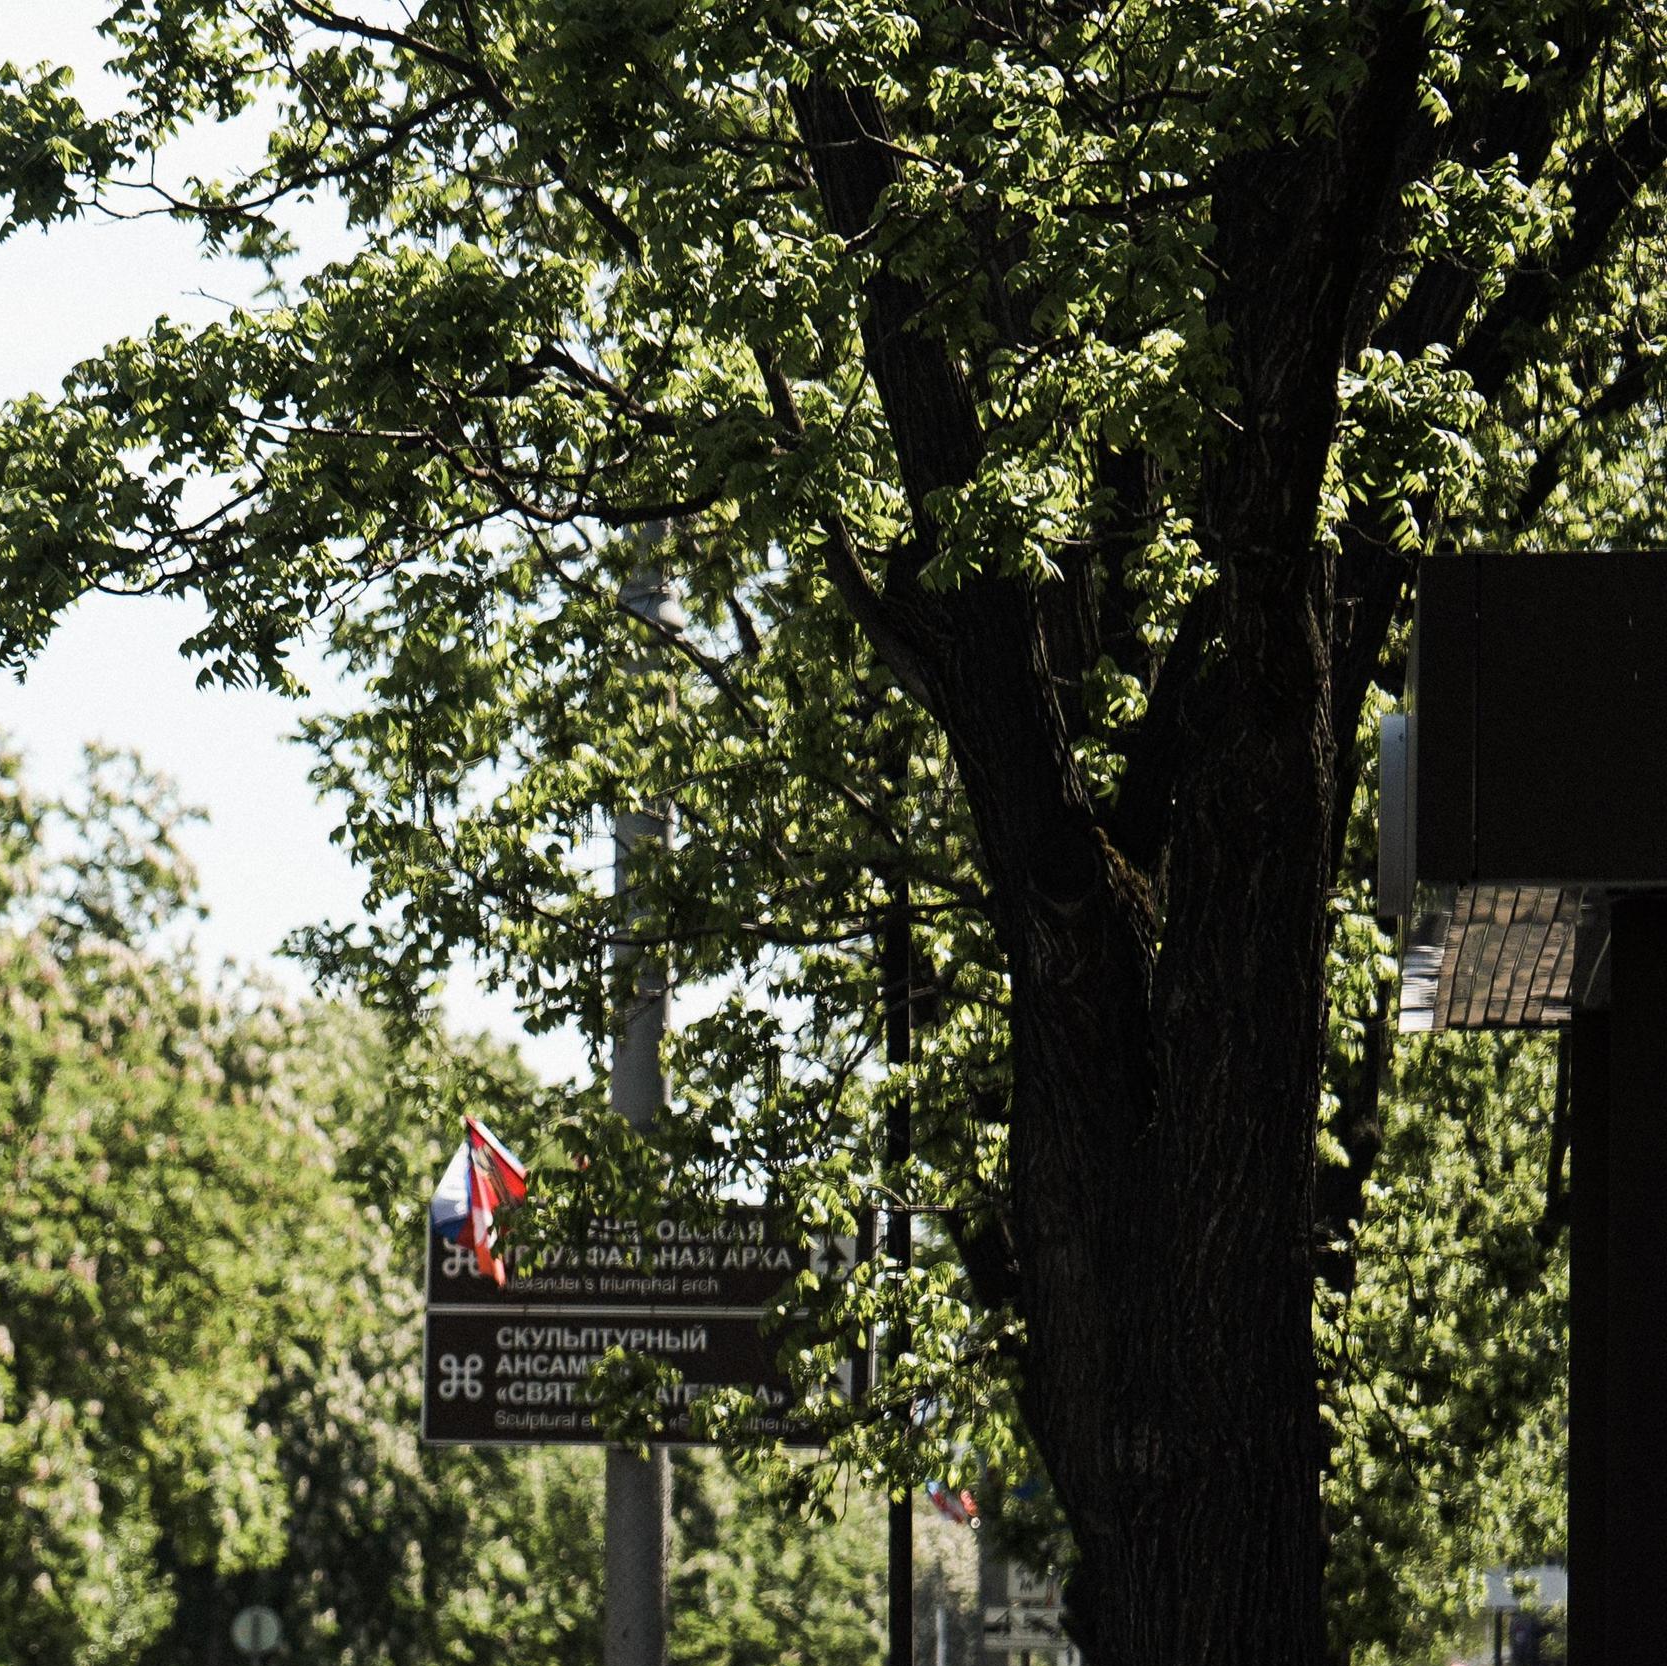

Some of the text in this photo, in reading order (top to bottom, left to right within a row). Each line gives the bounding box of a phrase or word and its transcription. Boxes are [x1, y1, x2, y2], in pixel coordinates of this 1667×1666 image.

[721, 1246, 793, 1271] АРКА
[505, 1275, 719, 1295] lexander's triumphal arch
[495, 1325, 708, 1351] СКУЛЬПТУРНЫЙ
[495, 1410, 576, 1431] Sculptural
